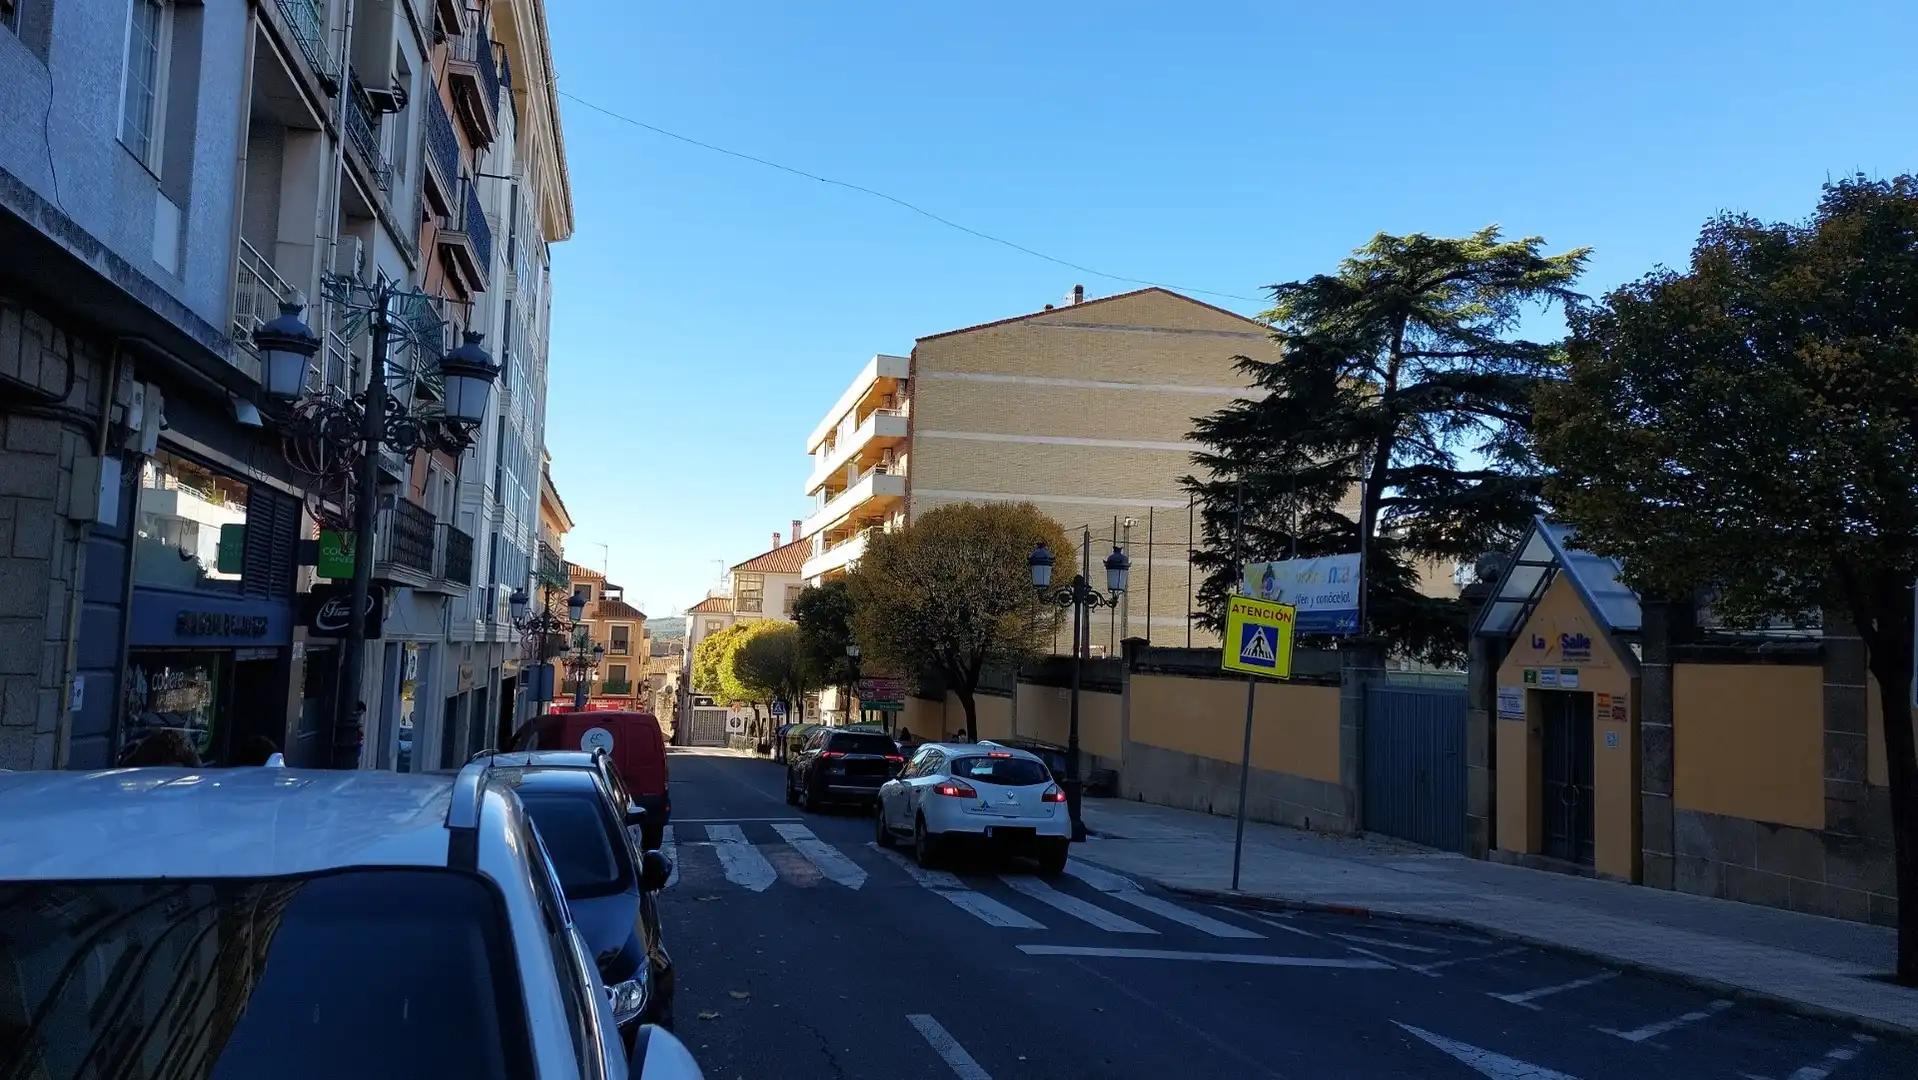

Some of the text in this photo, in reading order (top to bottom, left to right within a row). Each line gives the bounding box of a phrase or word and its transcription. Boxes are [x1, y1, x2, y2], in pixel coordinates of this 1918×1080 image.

[1231, 602, 1292, 623] ATENCIÓN
[1532, 632, 1591, 649] La Salle
